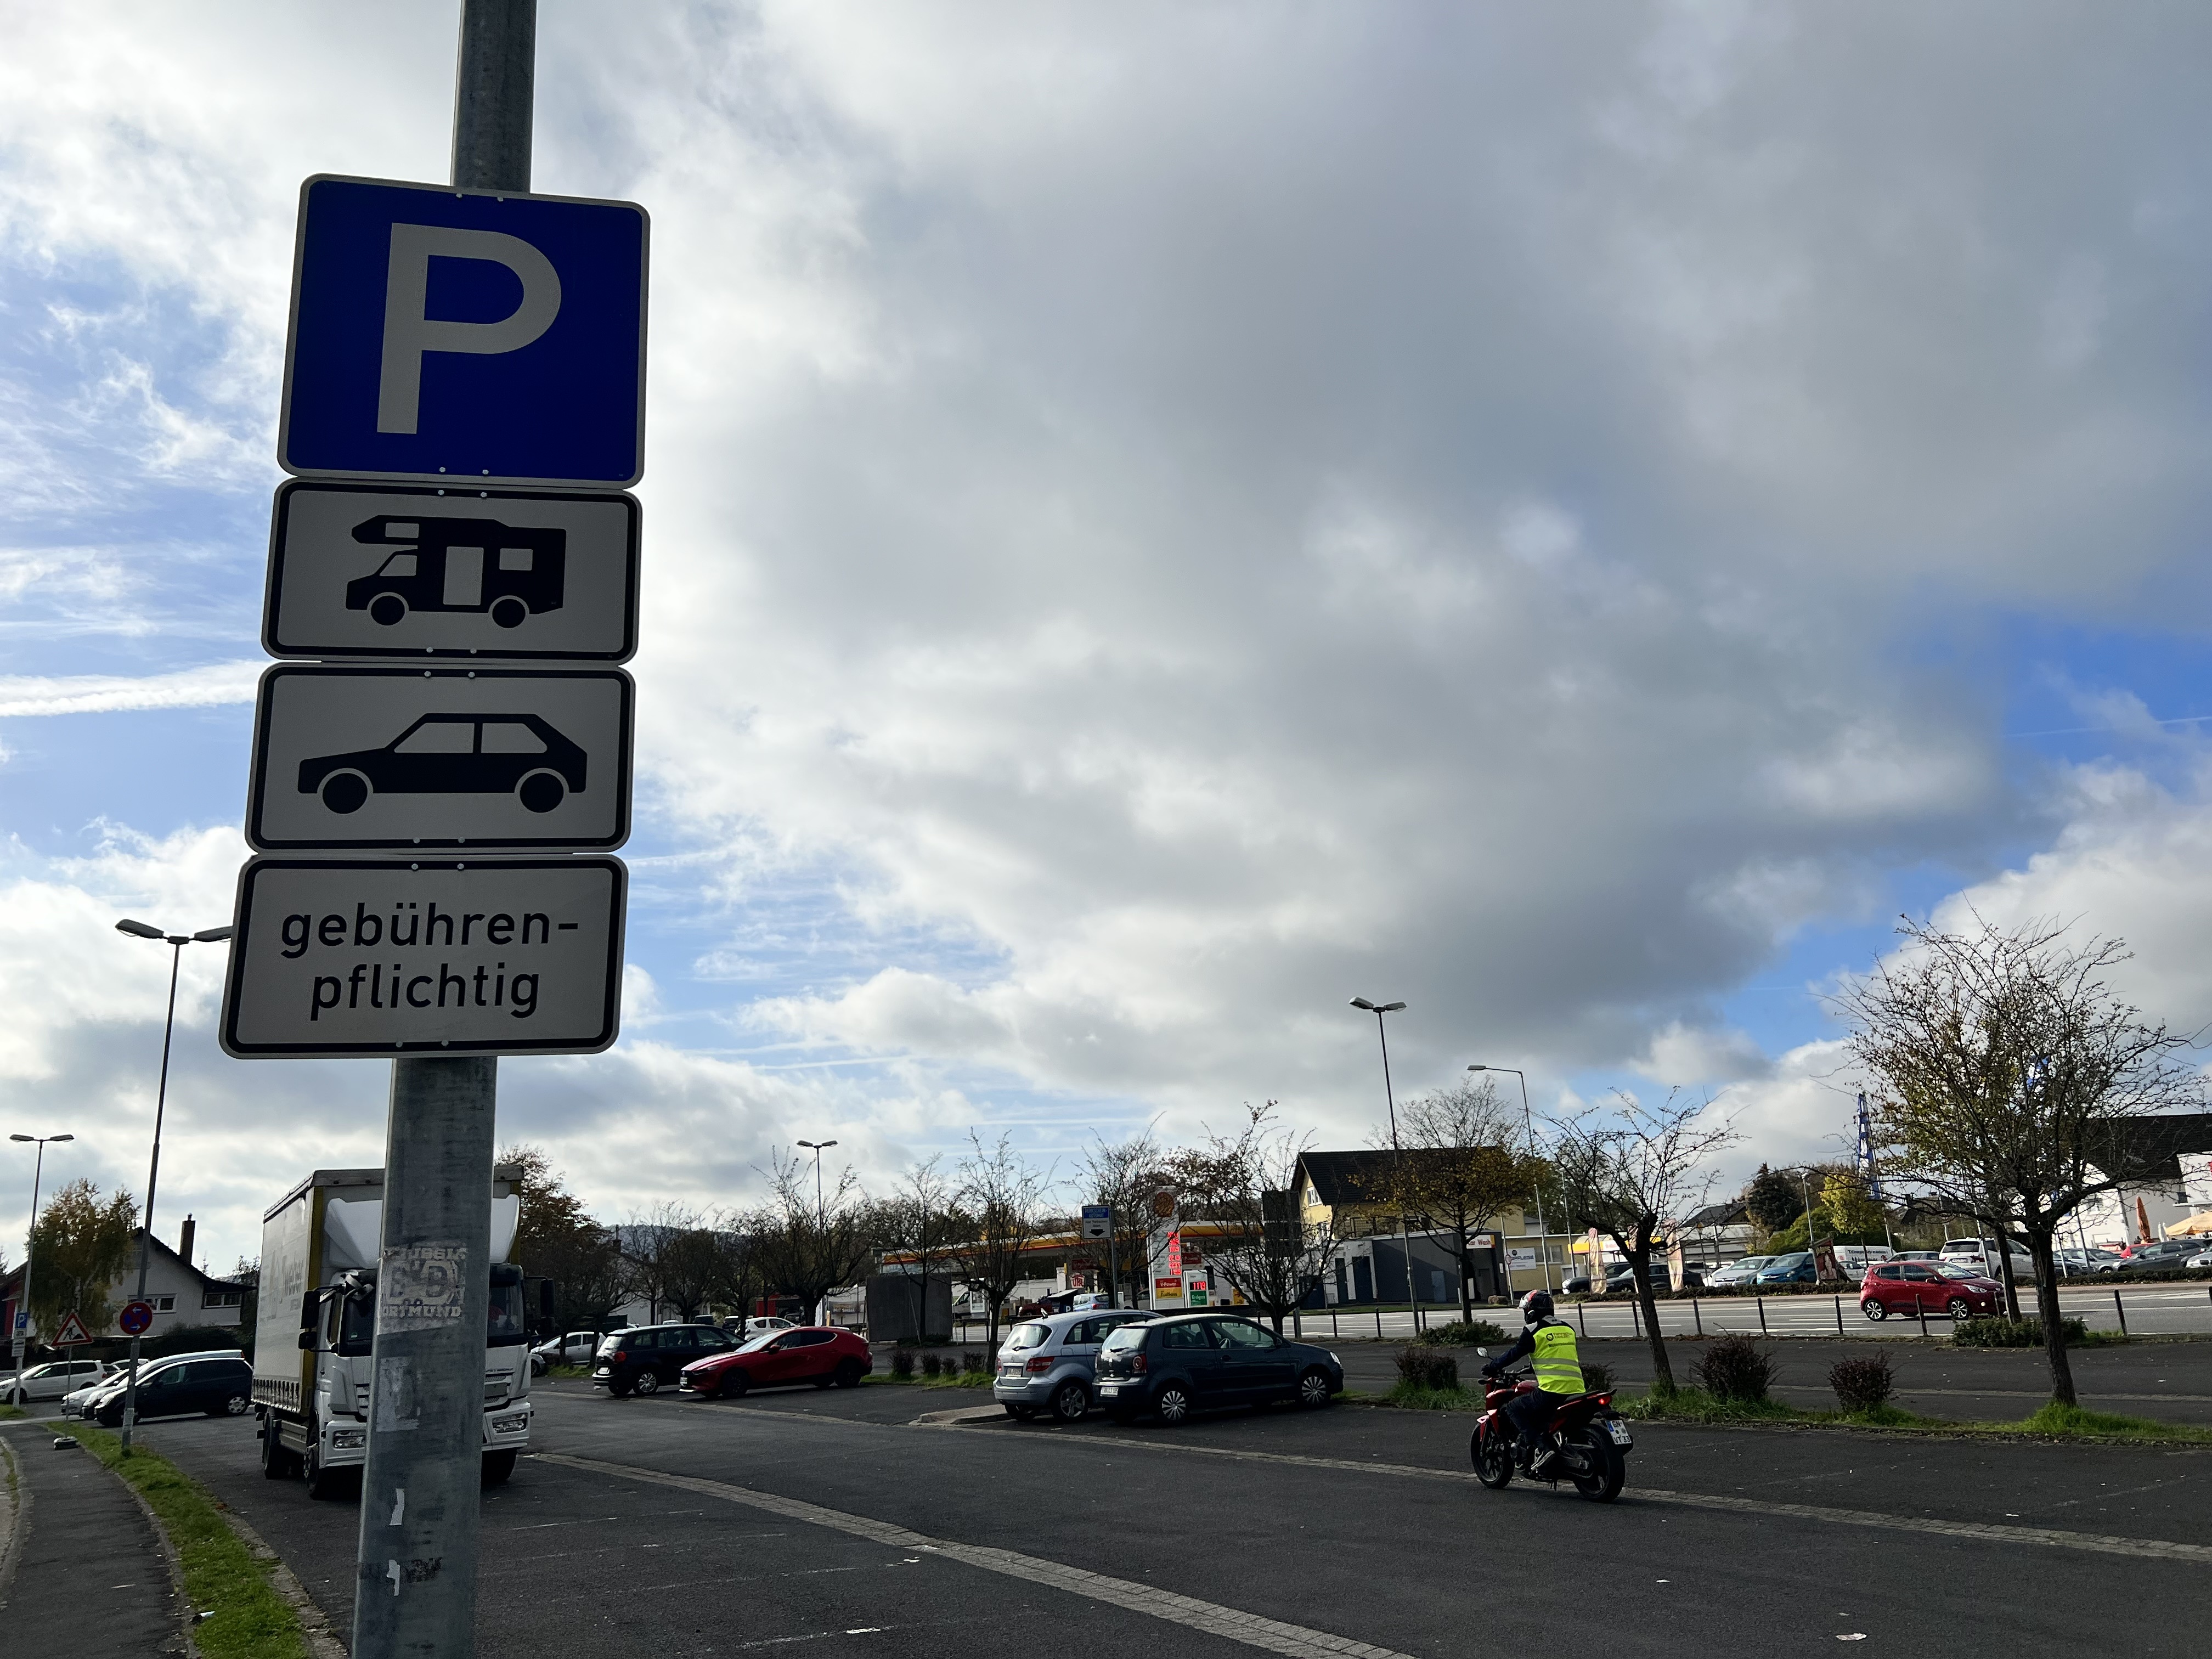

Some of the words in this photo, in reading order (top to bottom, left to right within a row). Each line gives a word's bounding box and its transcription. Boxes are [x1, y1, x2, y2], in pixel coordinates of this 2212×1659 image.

[377, 222, 562, 434] P
[280, 902, 579, 959] gebühren-
[310, 962, 539, 1022] pflichtig
[18, 1314, 25, 1327] P
[382, 1305, 462, 1318] ORTMUND
